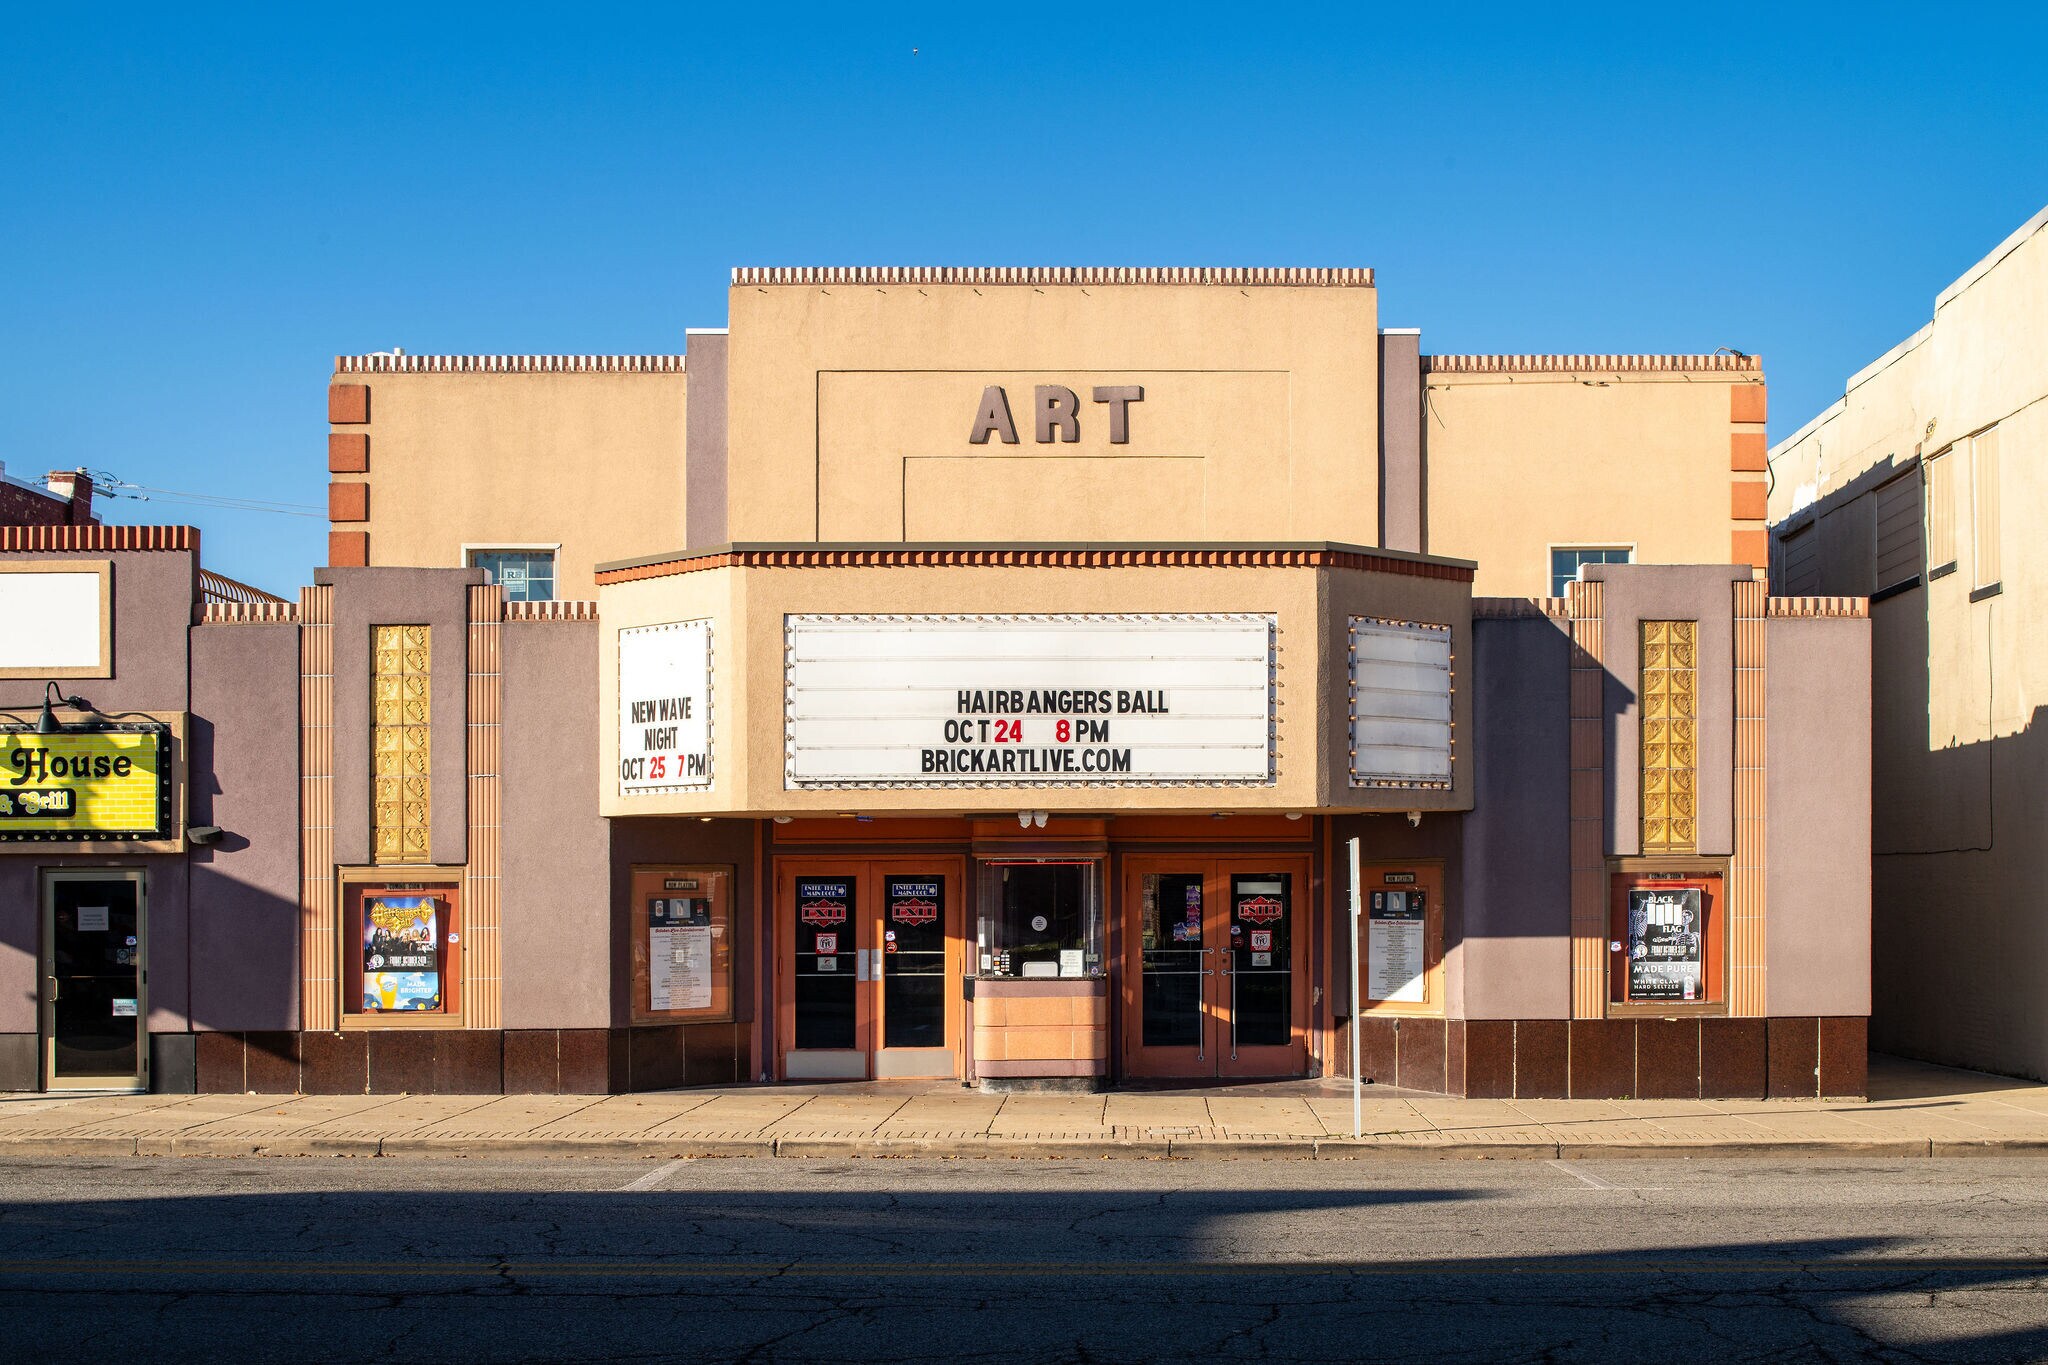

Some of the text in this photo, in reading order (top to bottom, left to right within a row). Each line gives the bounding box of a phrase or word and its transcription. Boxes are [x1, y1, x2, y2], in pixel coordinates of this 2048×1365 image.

[970, 385, 1144, 444] ART
[632, 696, 692, 724] NEW WAVE
[958, 690, 1168, 714] HAIRBANGERS BALL
[644, 727, 678, 750] NIGHT
[944, 720, 1109, 743] OCT 24 8 PM
[10, 748, 132, 785] House
[622, 754, 706, 780] OCT 25 7 PM
[922, 749, 1131, 773] BRICKARTLIVE.COM
[0, 791, 70, 815] & Grill
[803, 907, 845, 918] EXIT
[894, 907, 936, 917] EXIT
[1240, 906, 1281, 916] ENTER
